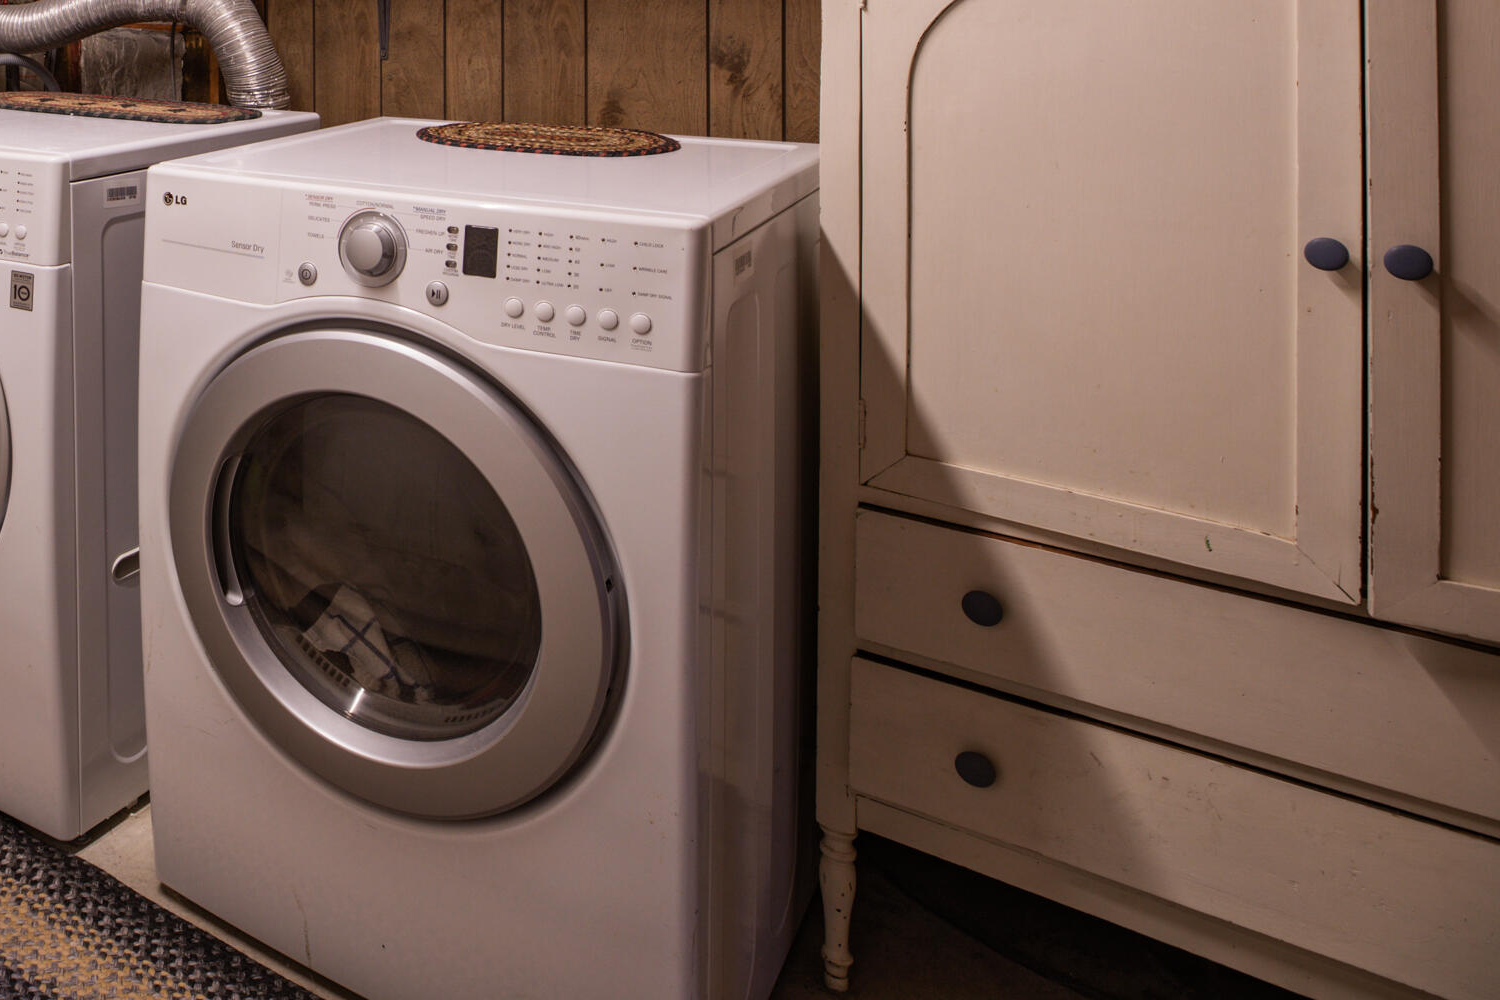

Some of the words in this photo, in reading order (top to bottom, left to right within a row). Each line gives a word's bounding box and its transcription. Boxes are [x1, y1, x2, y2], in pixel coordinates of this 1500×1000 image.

[231, 240, 252, 250] Sensor
[252, 242, 265, 254] Dry
[13, 284, 30, 301] 10
[631, 338, 652, 346] OPTION
